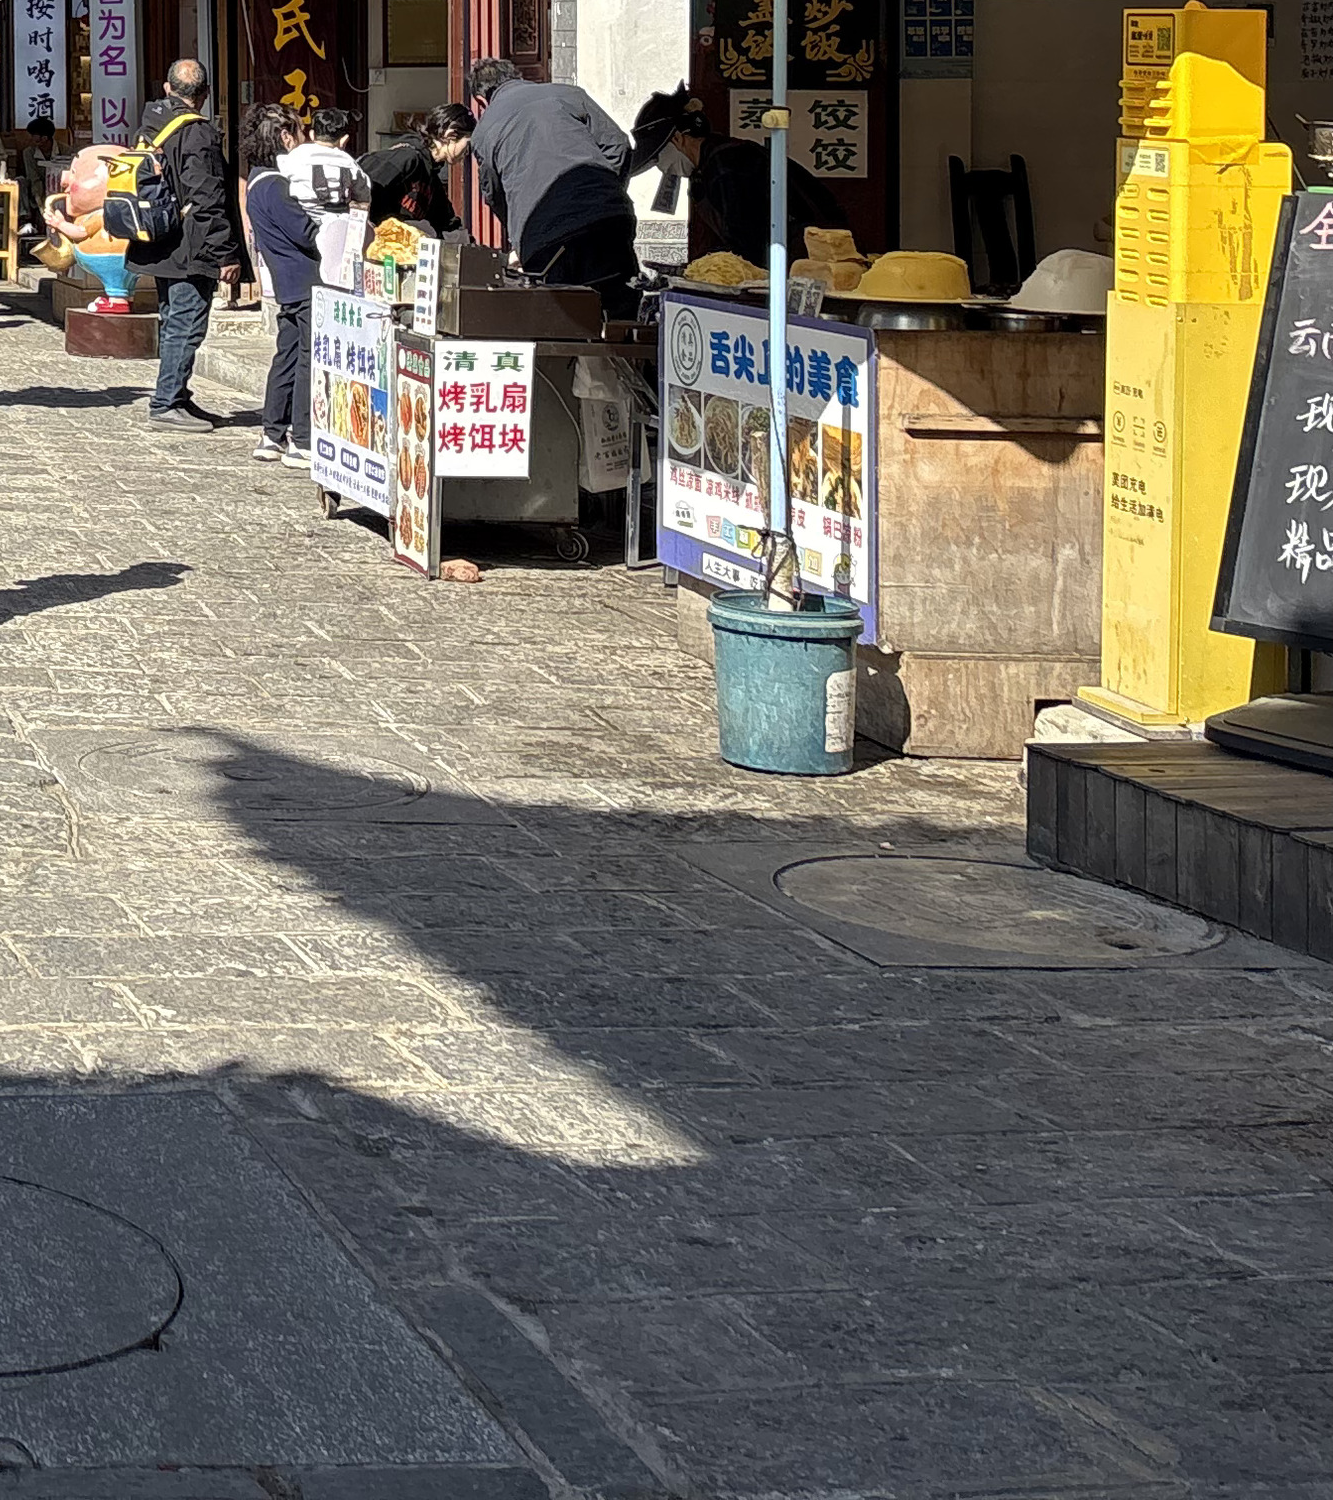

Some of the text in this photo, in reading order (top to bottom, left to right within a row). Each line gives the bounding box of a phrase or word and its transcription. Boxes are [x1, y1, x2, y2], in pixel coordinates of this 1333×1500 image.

[334, 300, 362, 328] 清真食品
[443, 351, 525, 373] 清真
[709, 330, 860, 409] 舌尖上的美食
[438, 381, 528, 414] 烤乳扇
[438, 422, 527, 454] 烤饵块
[1111, 471, 1147, 495] 美团充电
[1110, 493, 1165, 524] 给生活加满电
[705, 558, 740, 583] 人生大事
